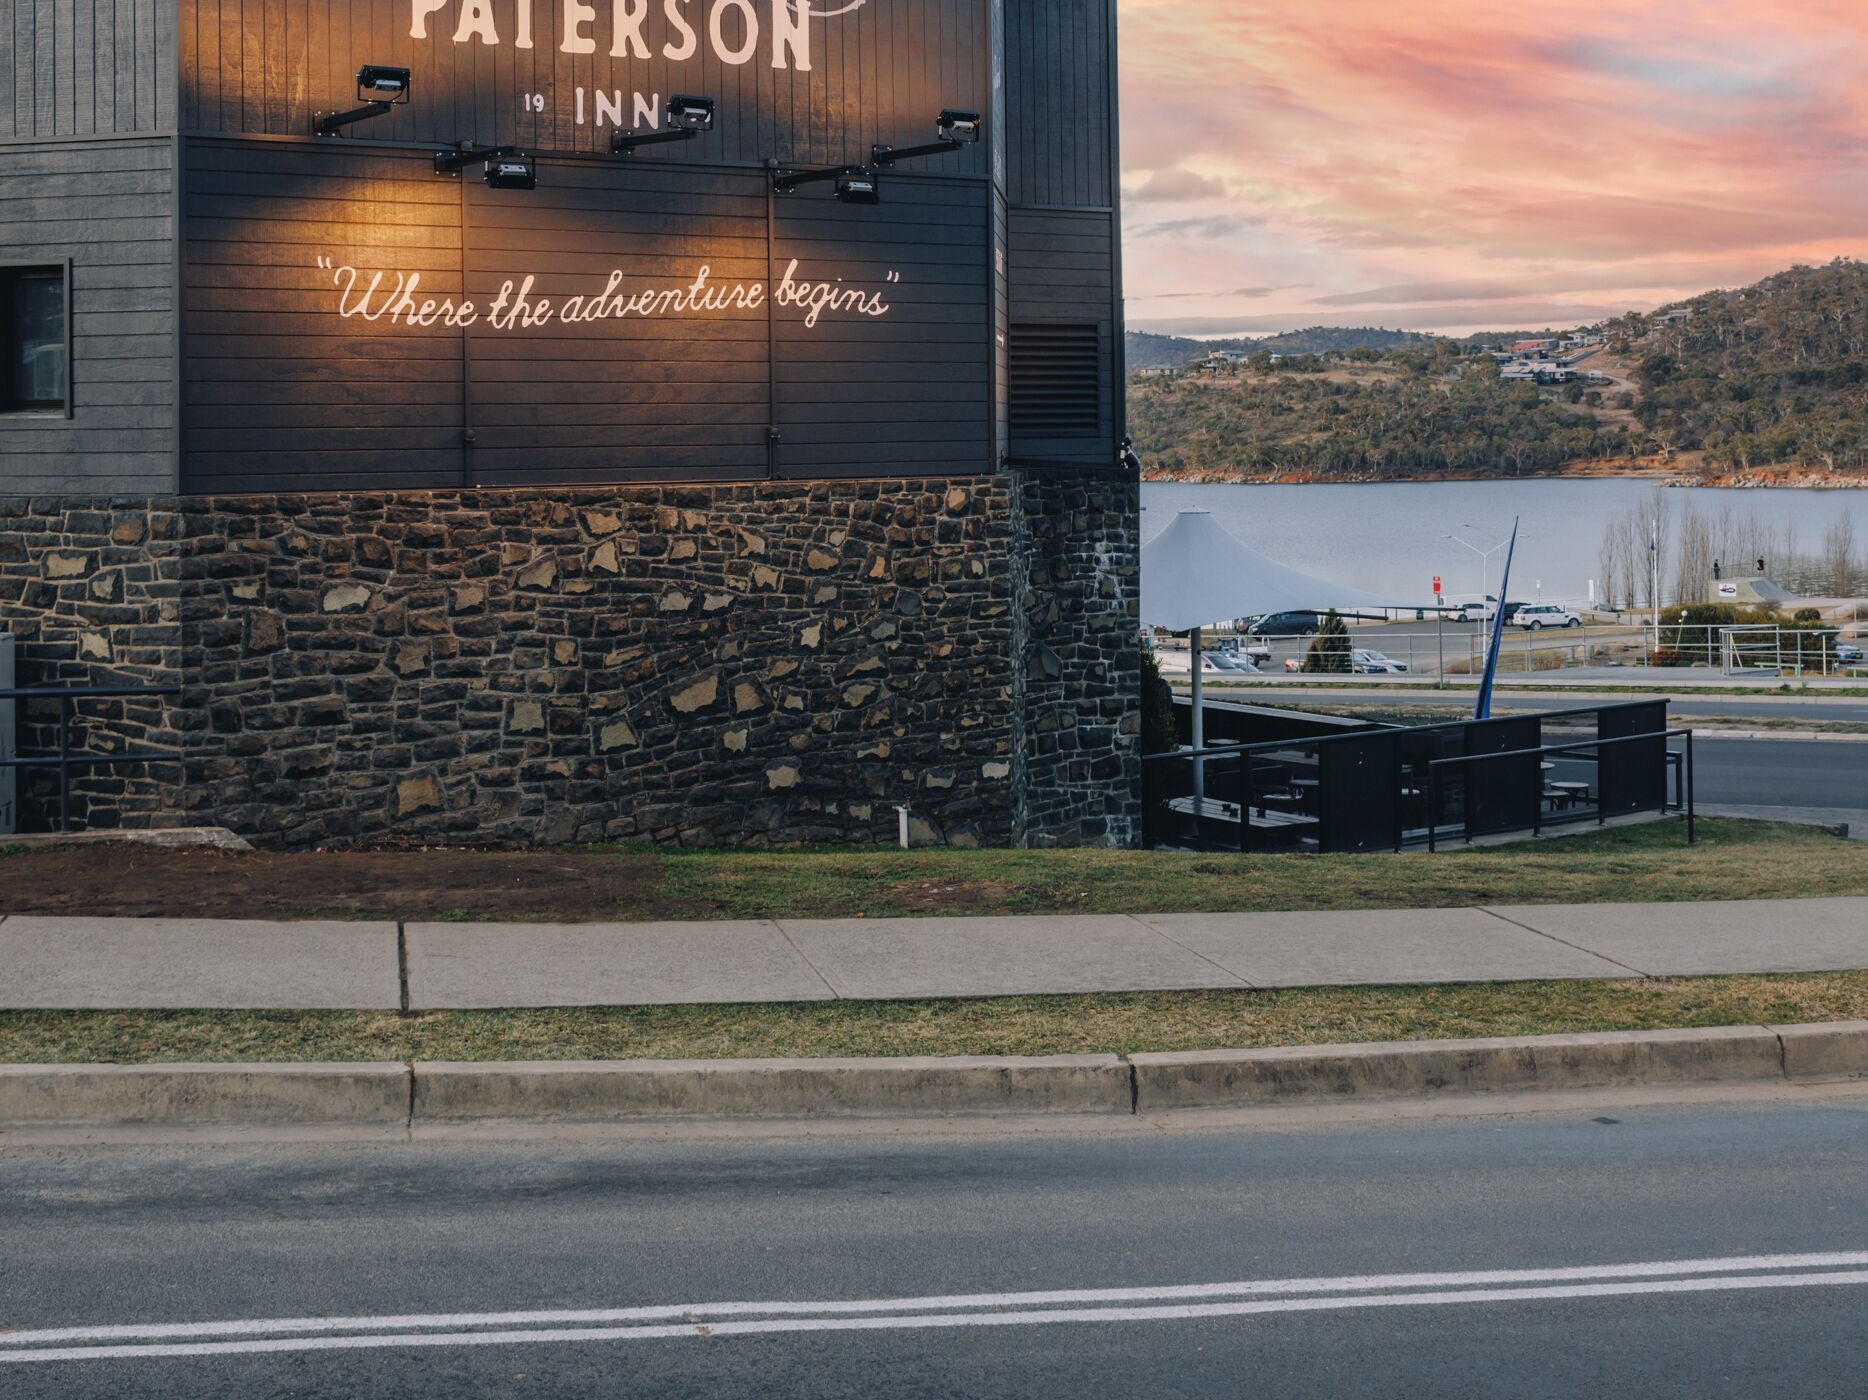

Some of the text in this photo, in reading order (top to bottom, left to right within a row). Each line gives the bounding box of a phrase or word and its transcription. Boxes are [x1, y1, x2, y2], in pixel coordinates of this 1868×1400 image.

[524, 92, 545, 113] 19
[575, 86, 659, 130] INN
[486, 274, 554, 331] the
[559, 264, 765, 324] adventure
